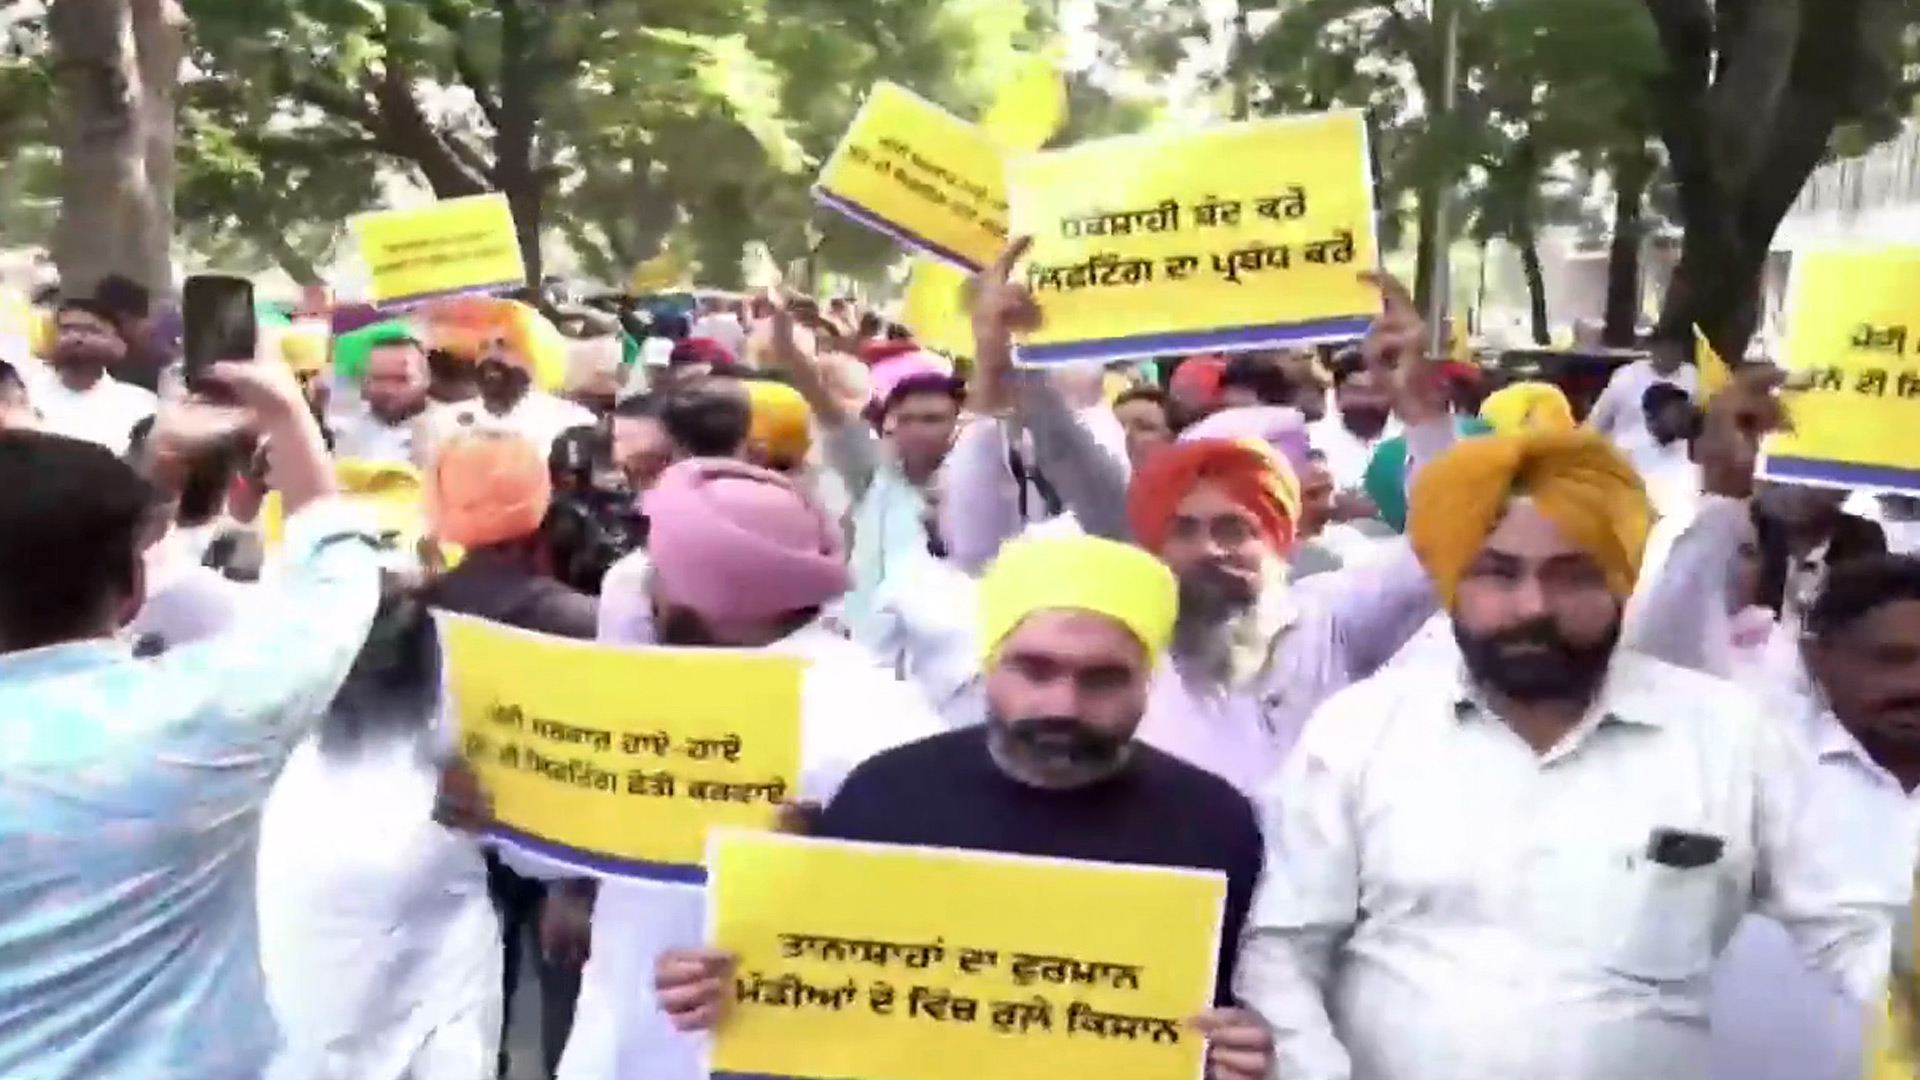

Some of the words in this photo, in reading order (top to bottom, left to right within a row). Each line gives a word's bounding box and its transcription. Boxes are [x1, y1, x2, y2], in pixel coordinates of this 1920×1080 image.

[1165, 256, 1198, 280] ਦਾ
[958, 947, 998, 974] ਦਾ
[870, 981, 894, 1014] ਦੇ
[1067, 1000, 1181, 1043] ਕਿਸਾਨ
